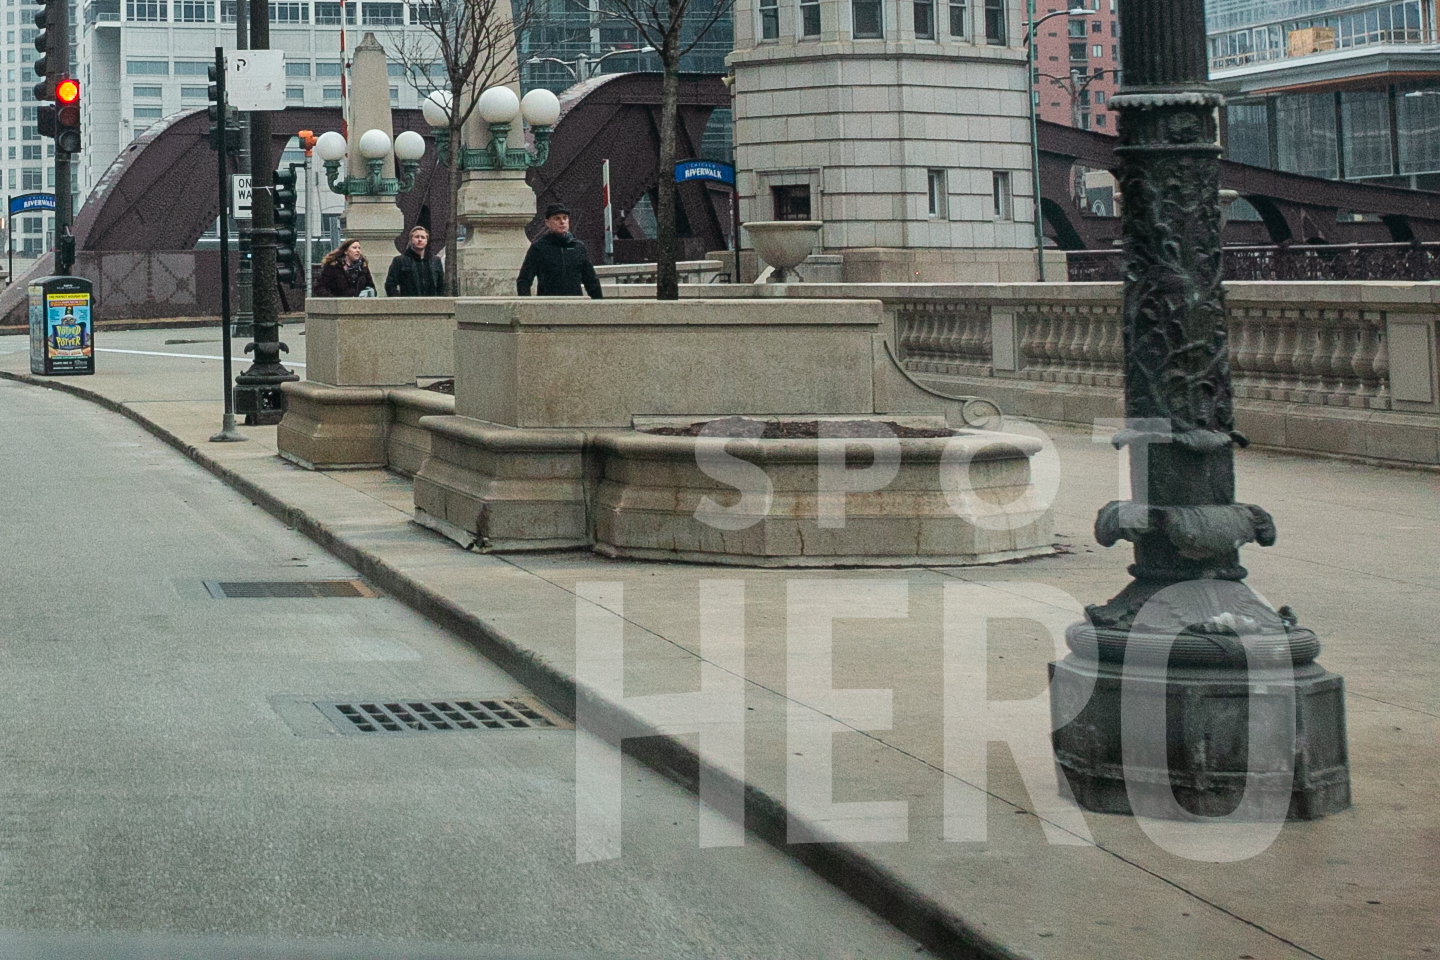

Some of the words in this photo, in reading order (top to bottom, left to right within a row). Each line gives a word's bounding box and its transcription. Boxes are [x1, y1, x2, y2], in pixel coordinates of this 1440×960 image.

[685, 168, 722, 179] RIVERWALK
[238, 178, 252, 188] ON
[238, 190, 252, 200] WA
[23, 200, 55, 208] RIVERWAL
[56, 336, 81, 347] POTTER
